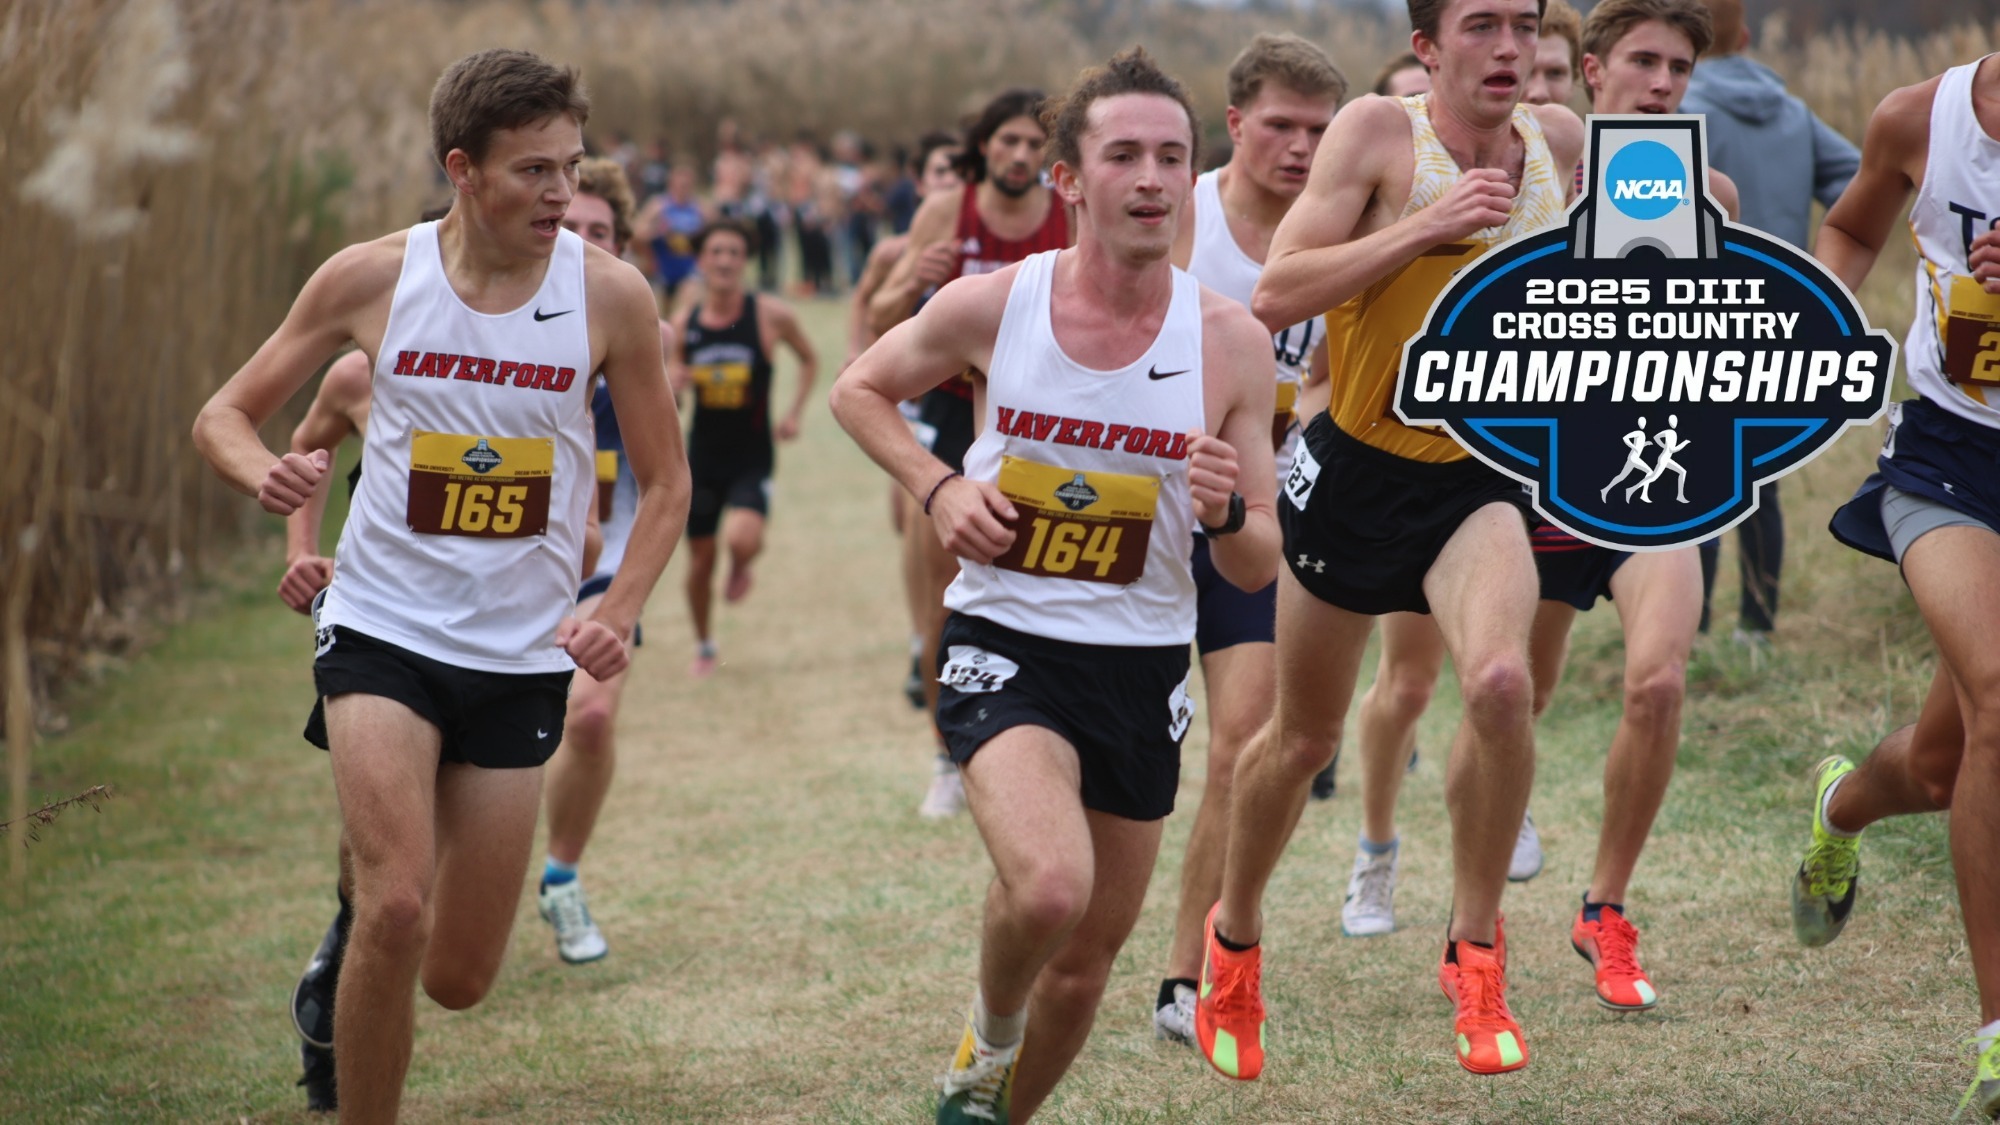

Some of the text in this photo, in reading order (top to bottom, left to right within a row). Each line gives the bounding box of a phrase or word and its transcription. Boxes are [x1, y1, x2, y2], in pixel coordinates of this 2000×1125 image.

[1949, 200, 2000, 273] T
[393, 350, 576, 393] HAVERFORD
[996, 405, 1190, 461] HAVERFORD
[441, 482, 528, 534] 165
[1022, 517, 1123, 577] 164
